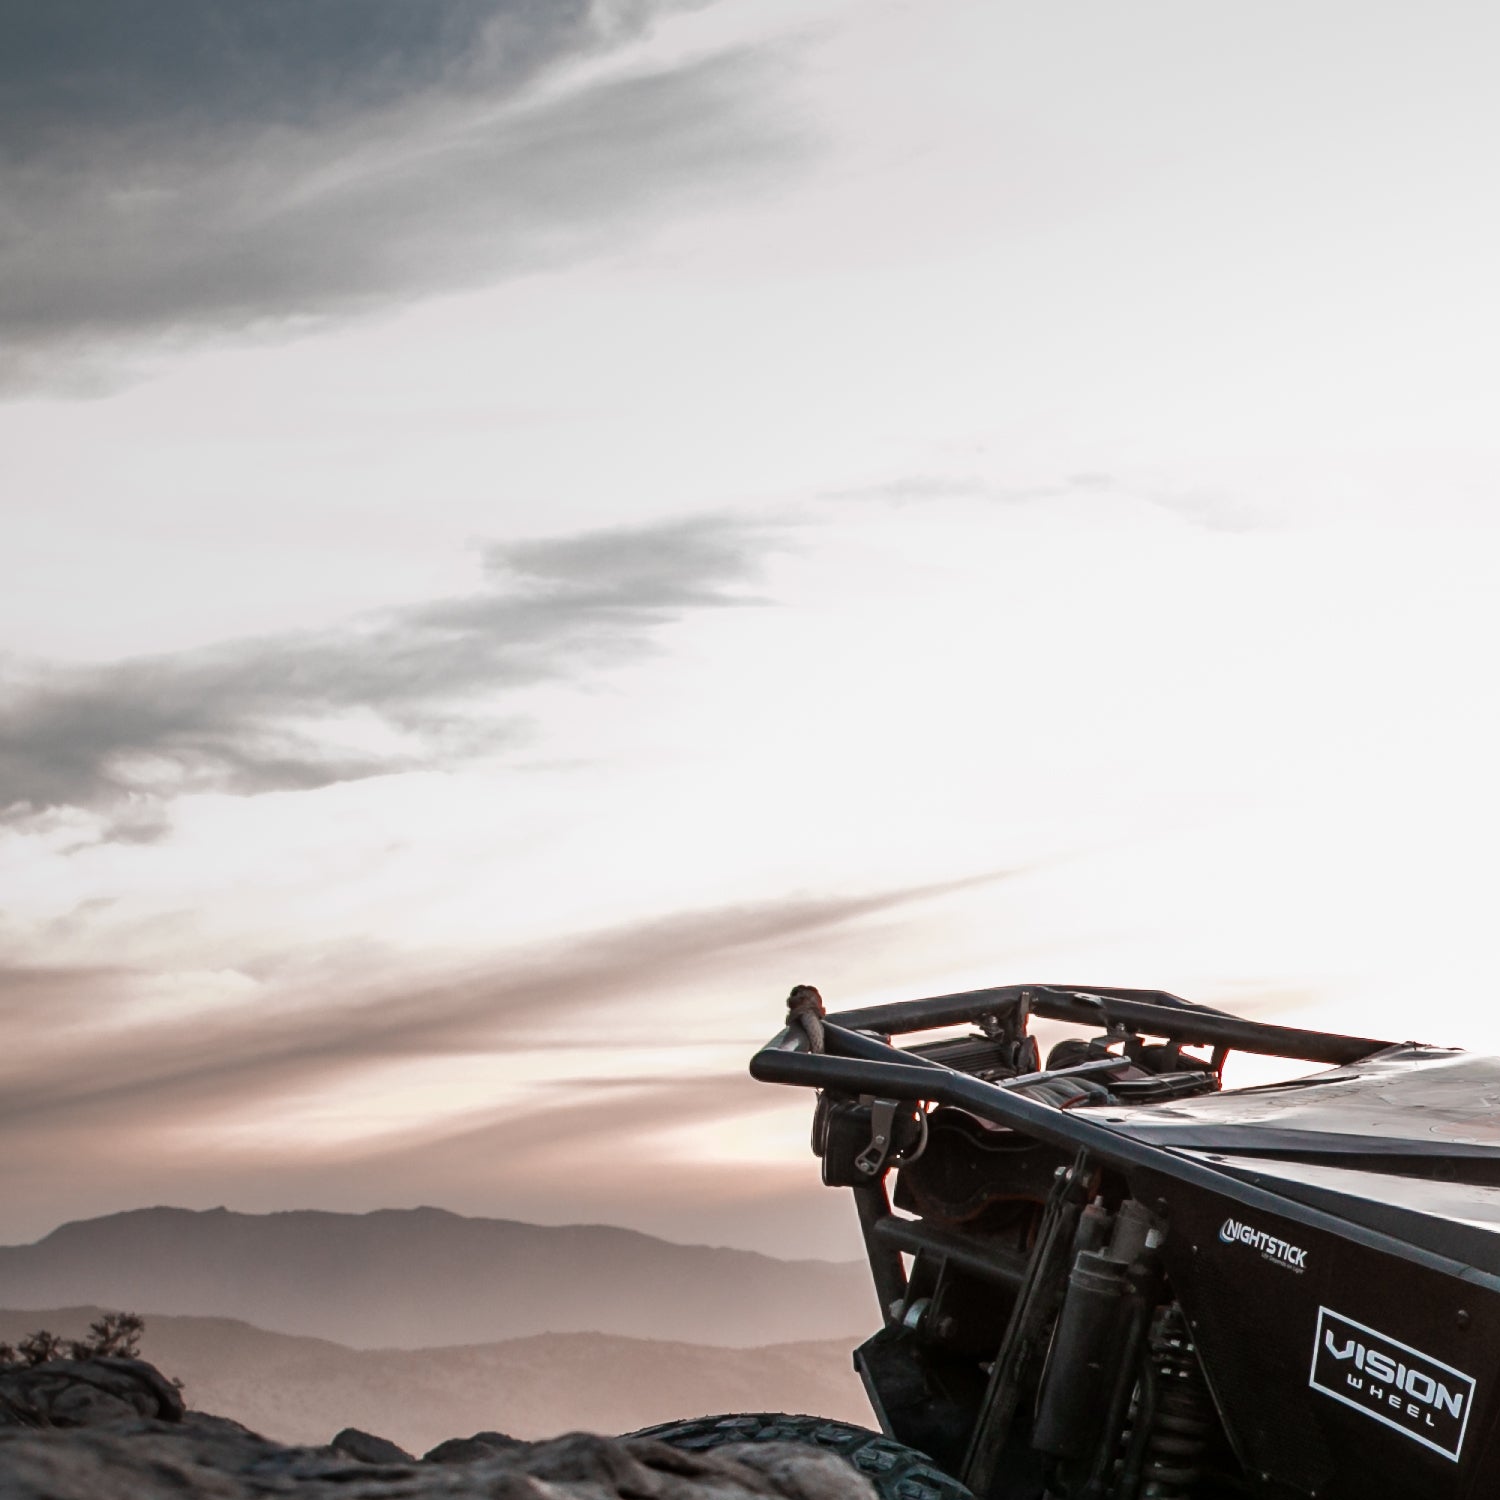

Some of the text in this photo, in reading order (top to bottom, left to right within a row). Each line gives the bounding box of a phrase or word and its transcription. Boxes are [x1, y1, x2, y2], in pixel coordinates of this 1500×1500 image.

[1222, 1218, 1308, 1268] NIGHTSTICK
[1325, 1329, 1464, 1419] VISION
[1346, 1373, 1435, 1427] WHEEL
